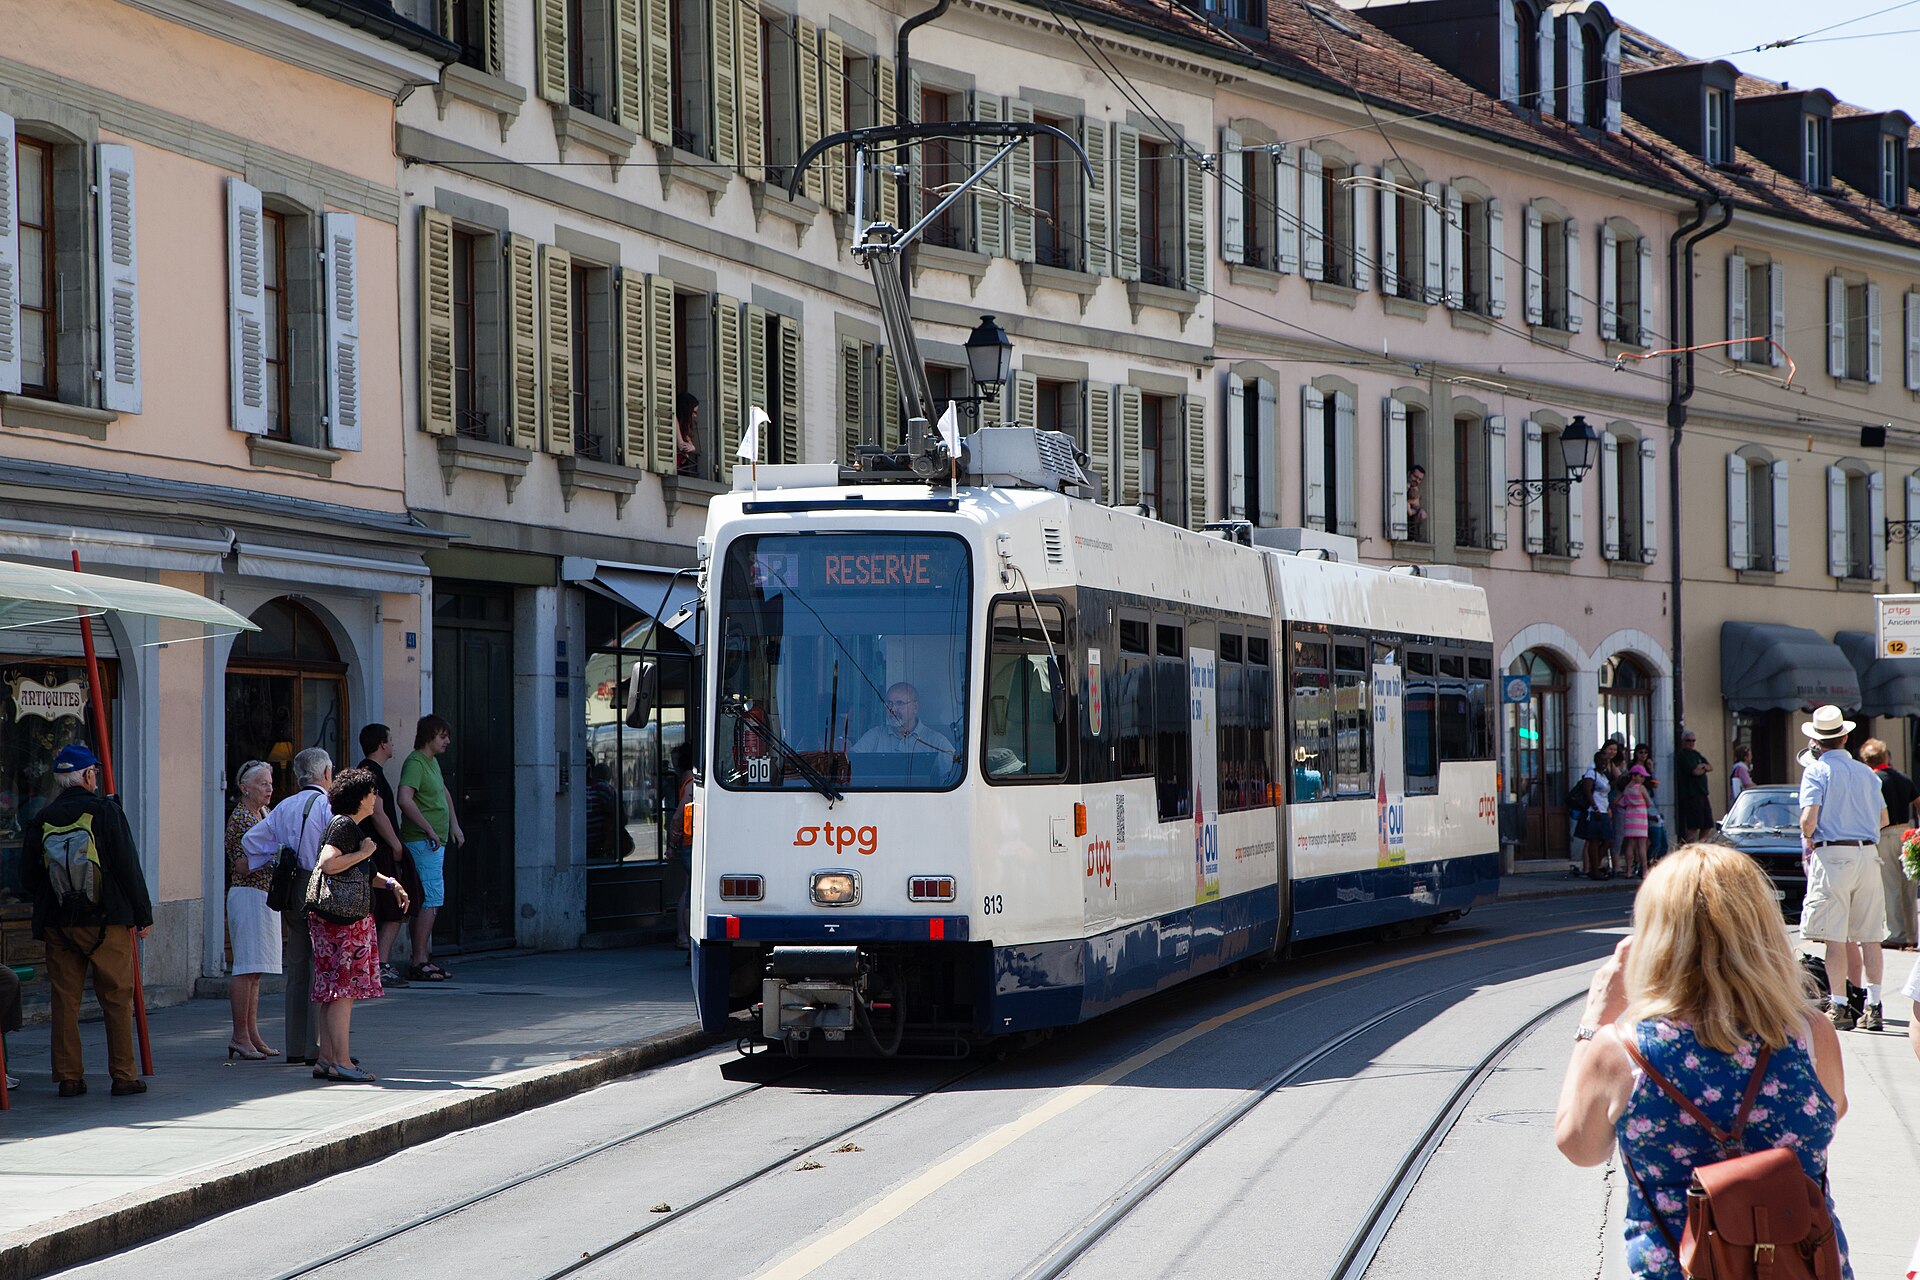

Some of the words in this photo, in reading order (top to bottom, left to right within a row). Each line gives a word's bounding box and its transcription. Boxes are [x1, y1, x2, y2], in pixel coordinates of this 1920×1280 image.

[825, 554, 930, 585] RESERVE
[1890, 642, 1904, 652] 12
[1191, 656, 1201, 688] Pour
[1374, 671, 1385, 696] Pour
[21, 690, 80, 709] ANTIQUITES
[1388, 805, 1404, 835] OUI
[1205, 824, 1218, 862] OUI
[983, 894, 1003, 915] 813
